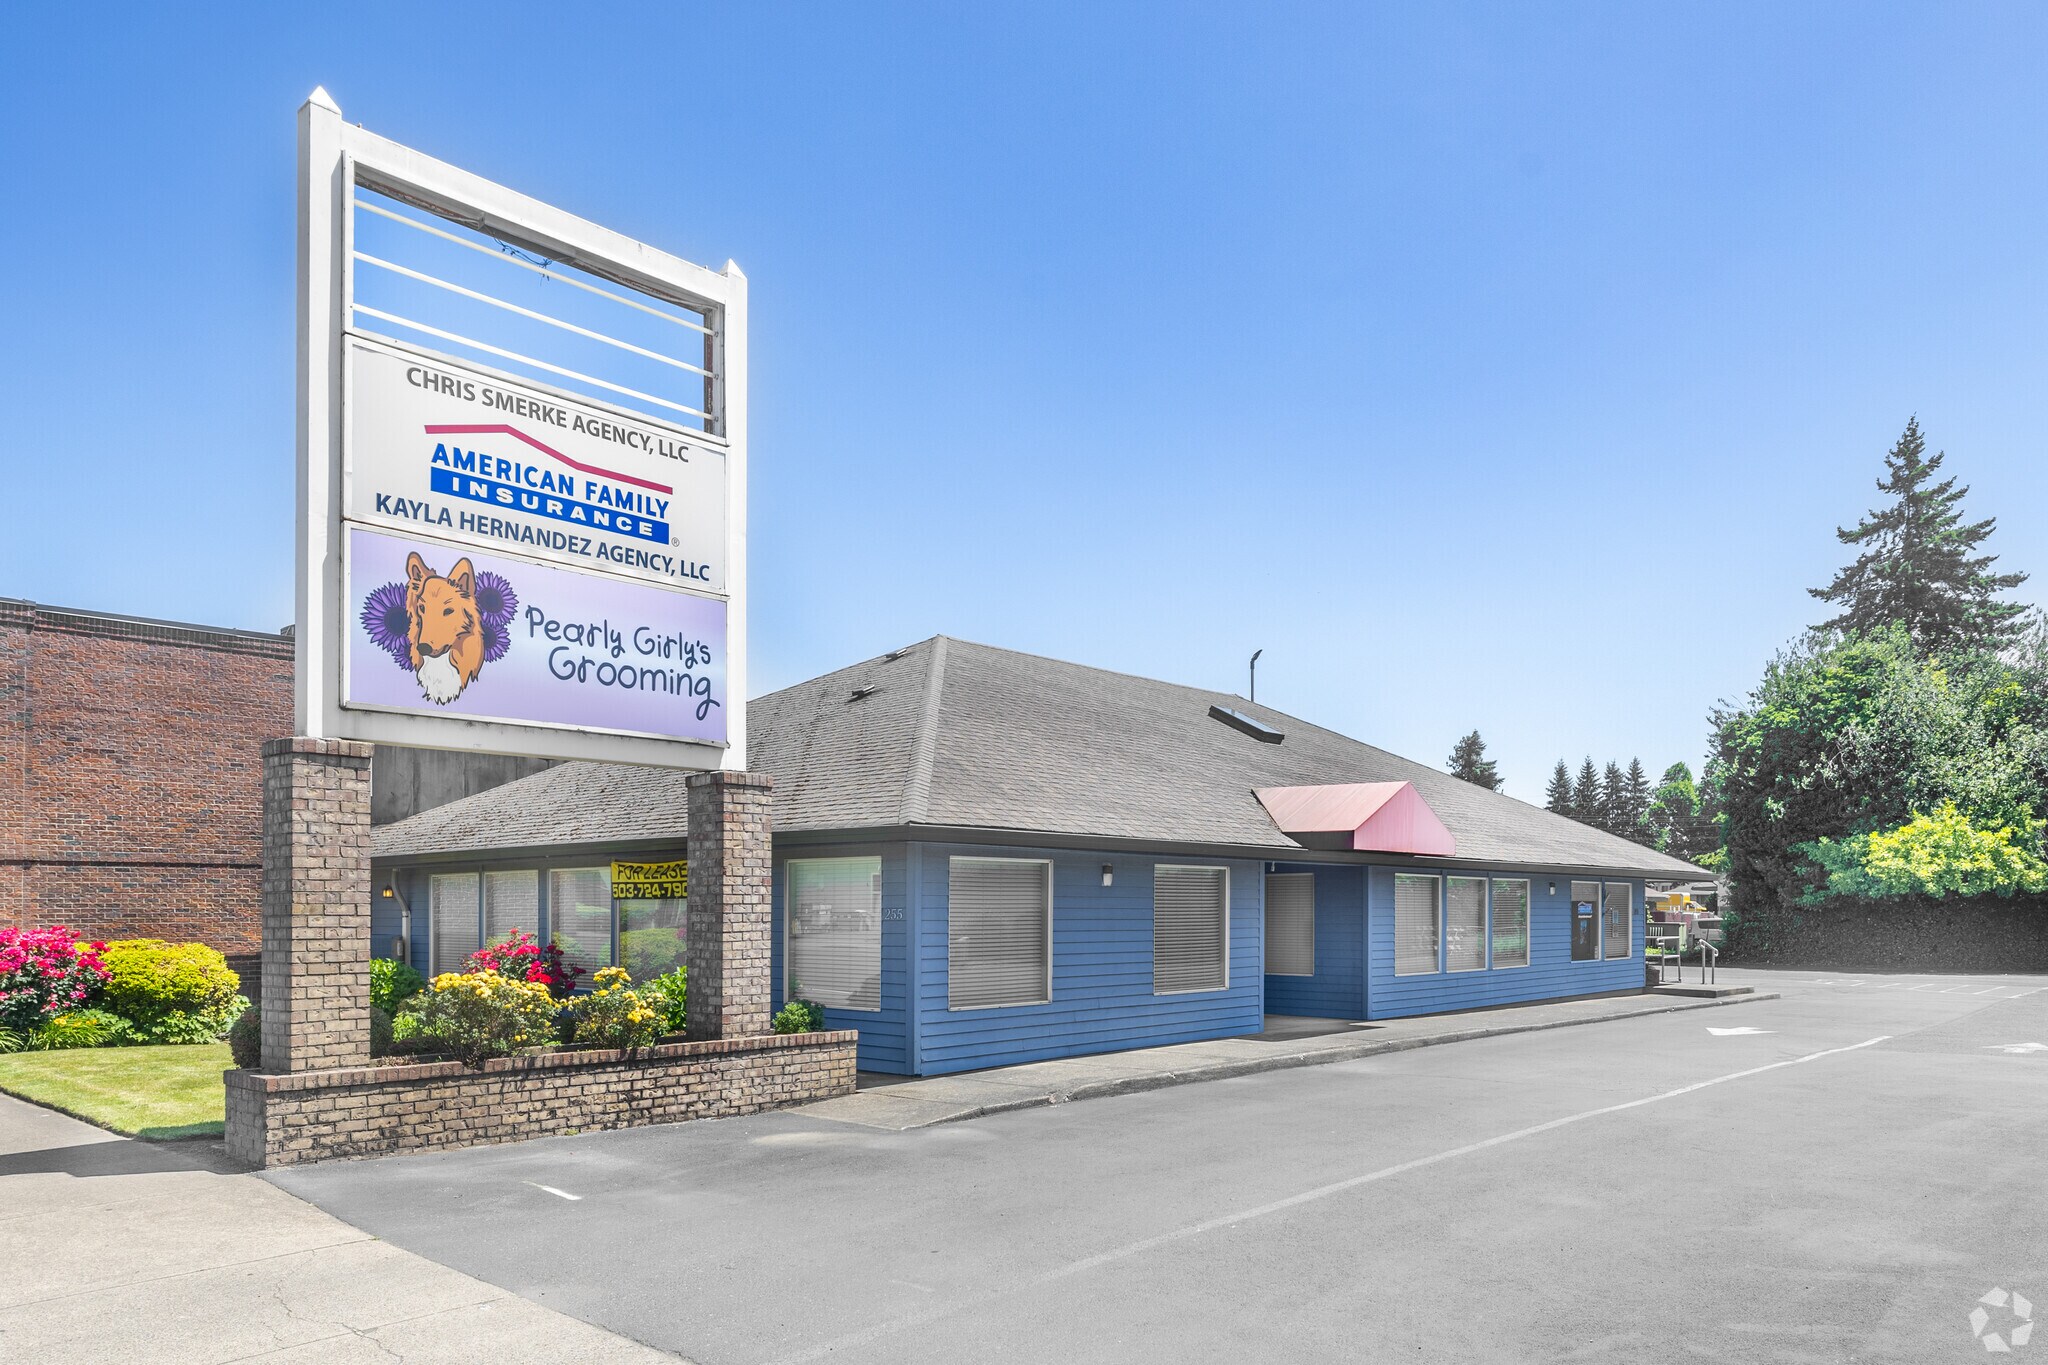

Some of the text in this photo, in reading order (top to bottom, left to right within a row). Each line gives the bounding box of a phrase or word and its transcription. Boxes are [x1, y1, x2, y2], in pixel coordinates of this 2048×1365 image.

[406, 367, 690, 464] CHRIS SMERKE AGENCY, LLC
[431, 442, 670, 520] AMERICAN FAMILY
[451, 476, 655, 538] INSURANCE
[375, 492, 711, 582] KAYLA HERNANDEZ AGENCY, LLC
[525, 604, 712, 671] Pearly Girly's
[548, 645, 722, 722] Grooming
[617, 862, 688, 881] FOR LEASE
[884, 908, 903, 920] 255
